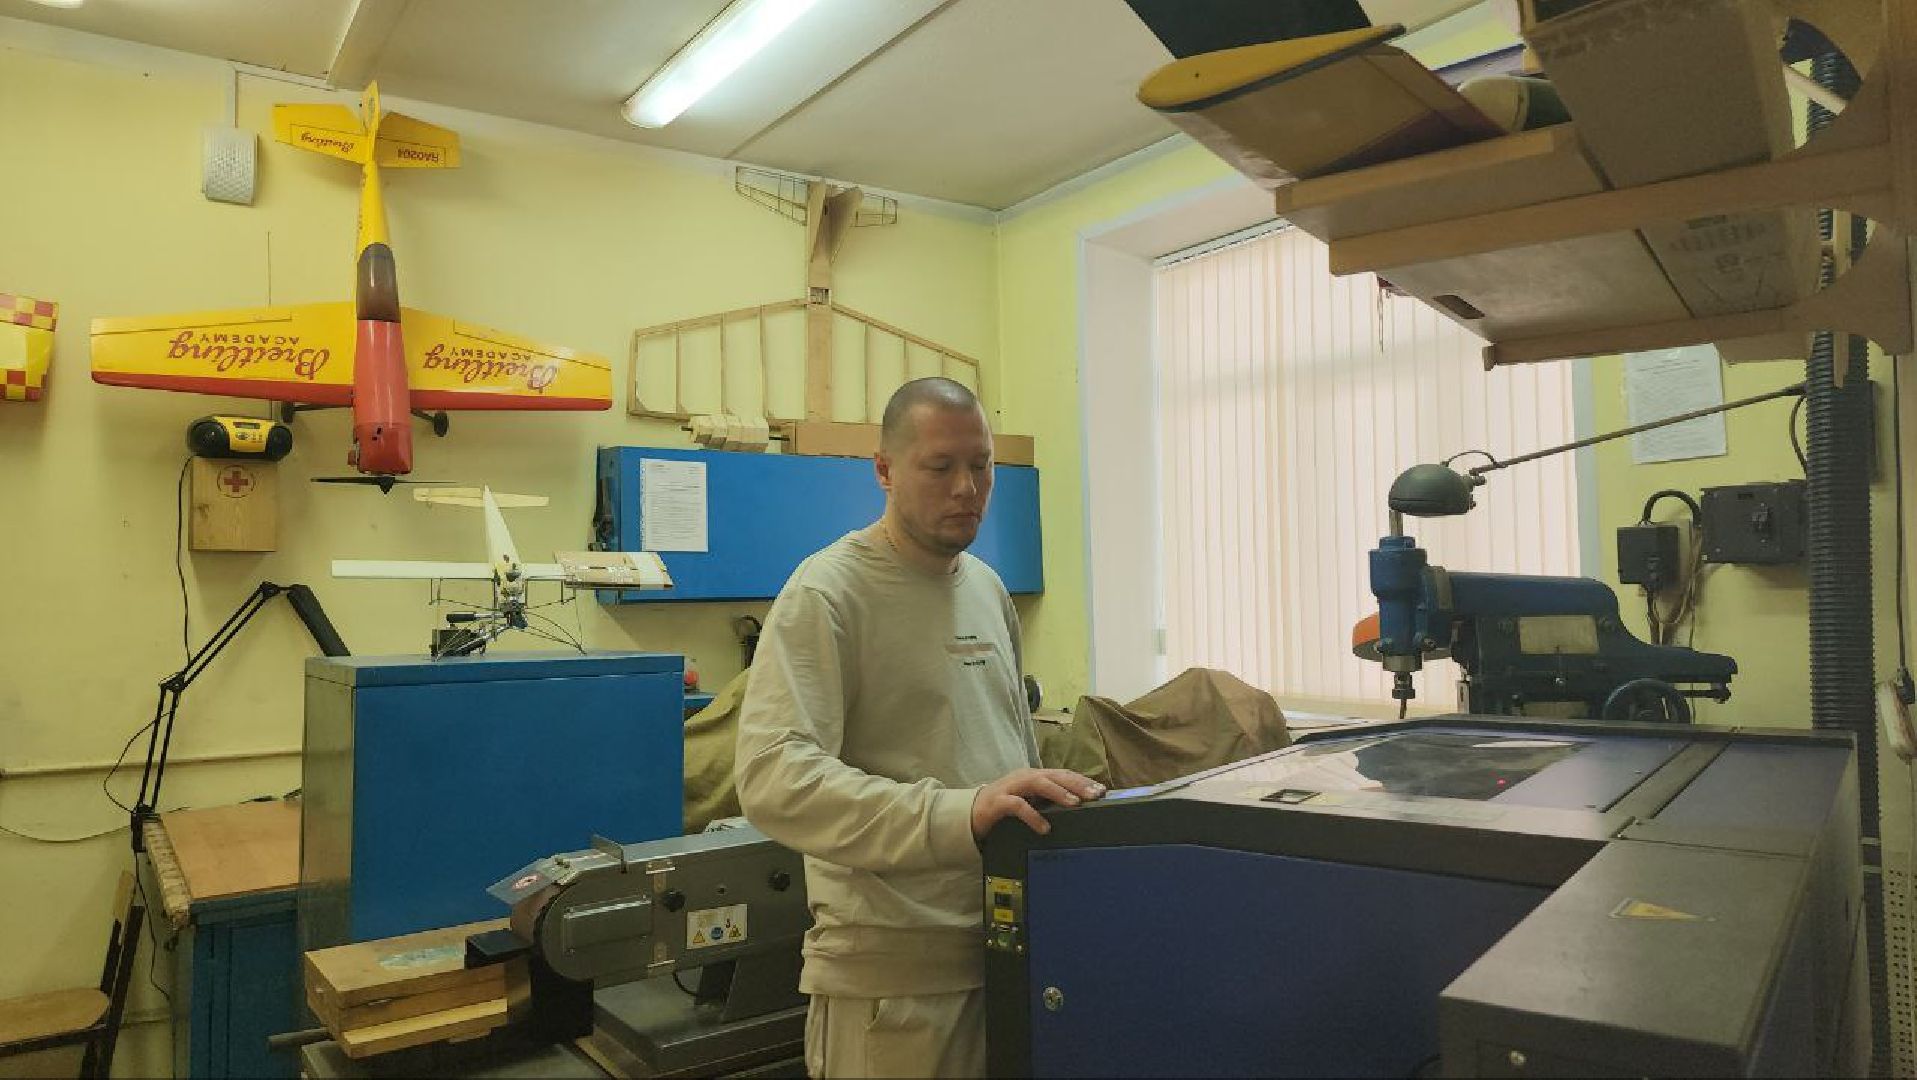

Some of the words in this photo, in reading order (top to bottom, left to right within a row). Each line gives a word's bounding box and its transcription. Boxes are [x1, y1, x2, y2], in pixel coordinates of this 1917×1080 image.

[200, 333, 299, 345] ACADEMY
[451, 347, 532, 361] ACADEMY
[168, 331, 330, 380] Breitling
[423, 344, 557, 393] Breitling
